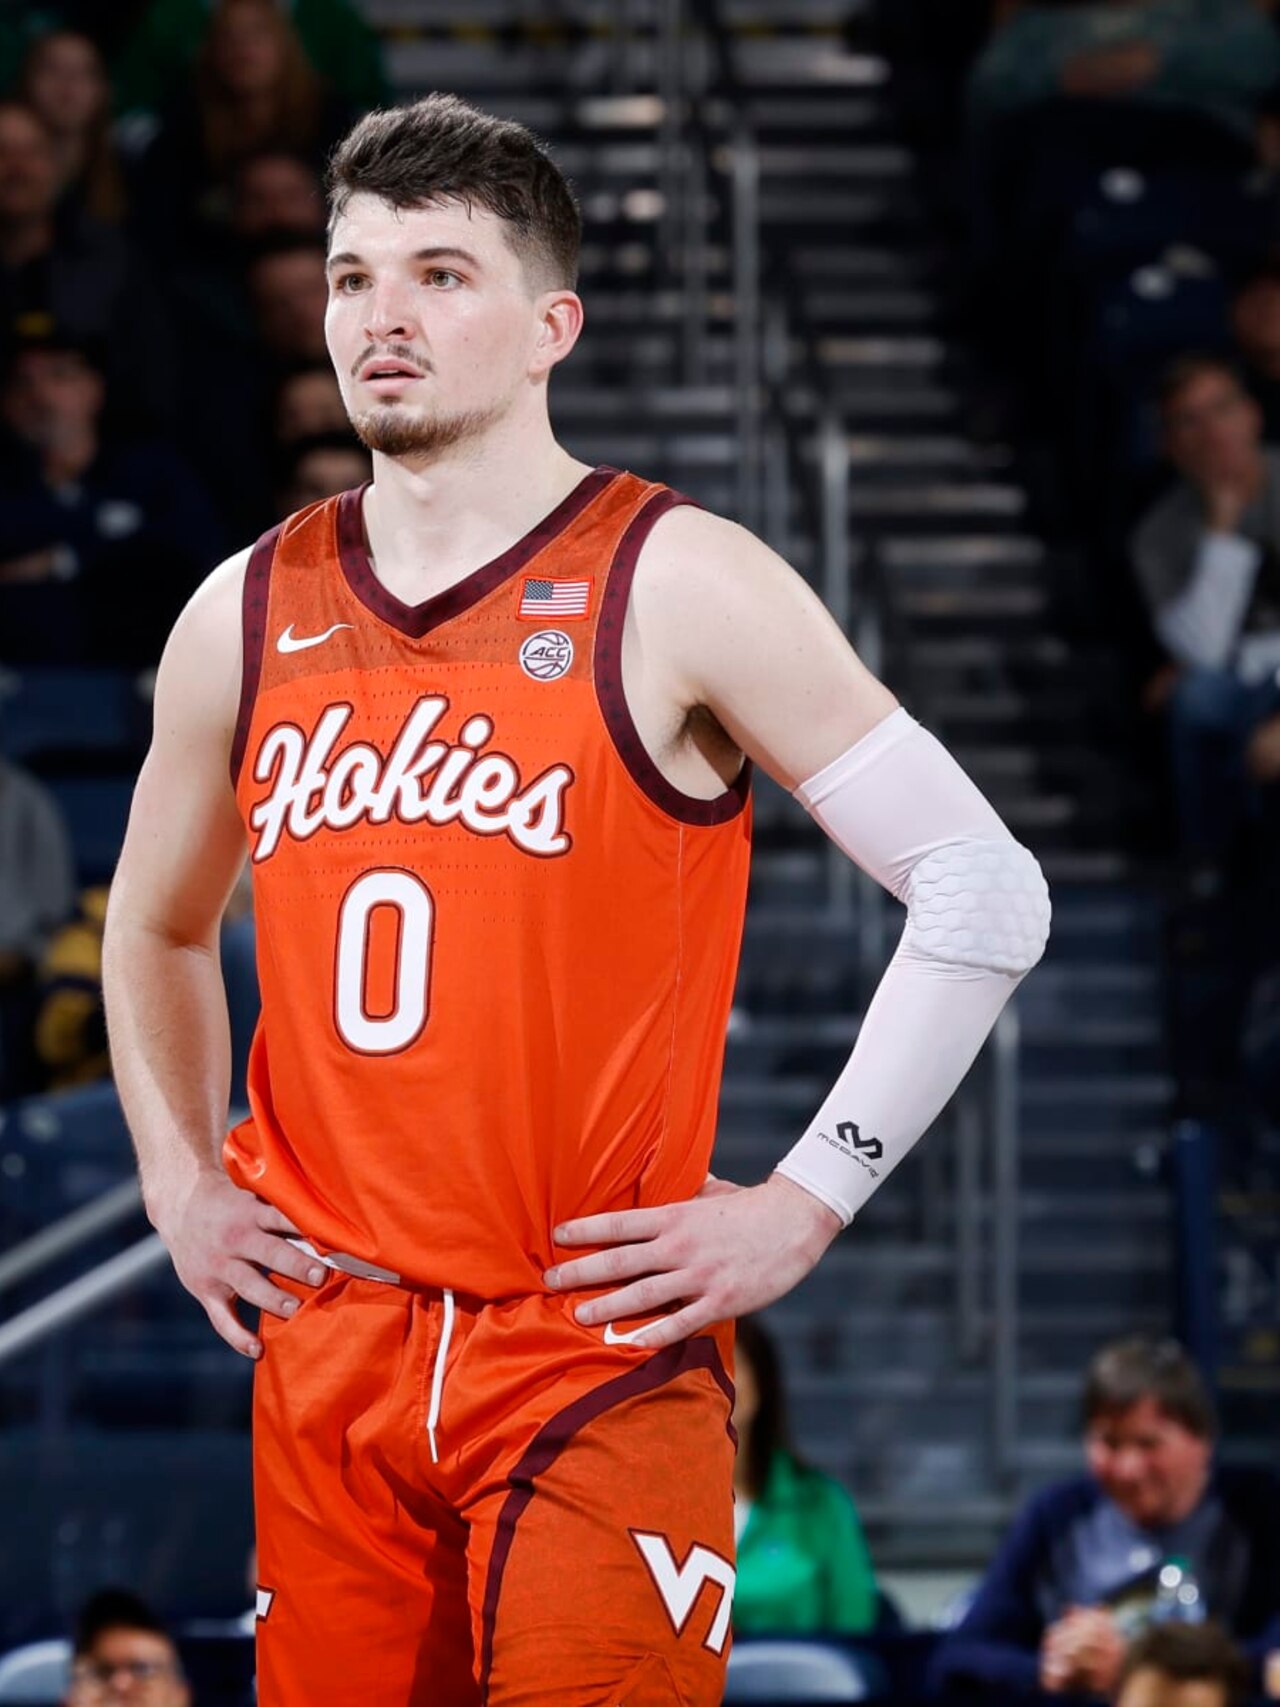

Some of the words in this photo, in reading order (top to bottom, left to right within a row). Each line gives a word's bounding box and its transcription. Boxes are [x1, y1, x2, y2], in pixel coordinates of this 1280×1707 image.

[529, 646, 569, 658] ACC
[251, 695, 575, 860] Hokies
[333, 866, 435, 1057] 0
